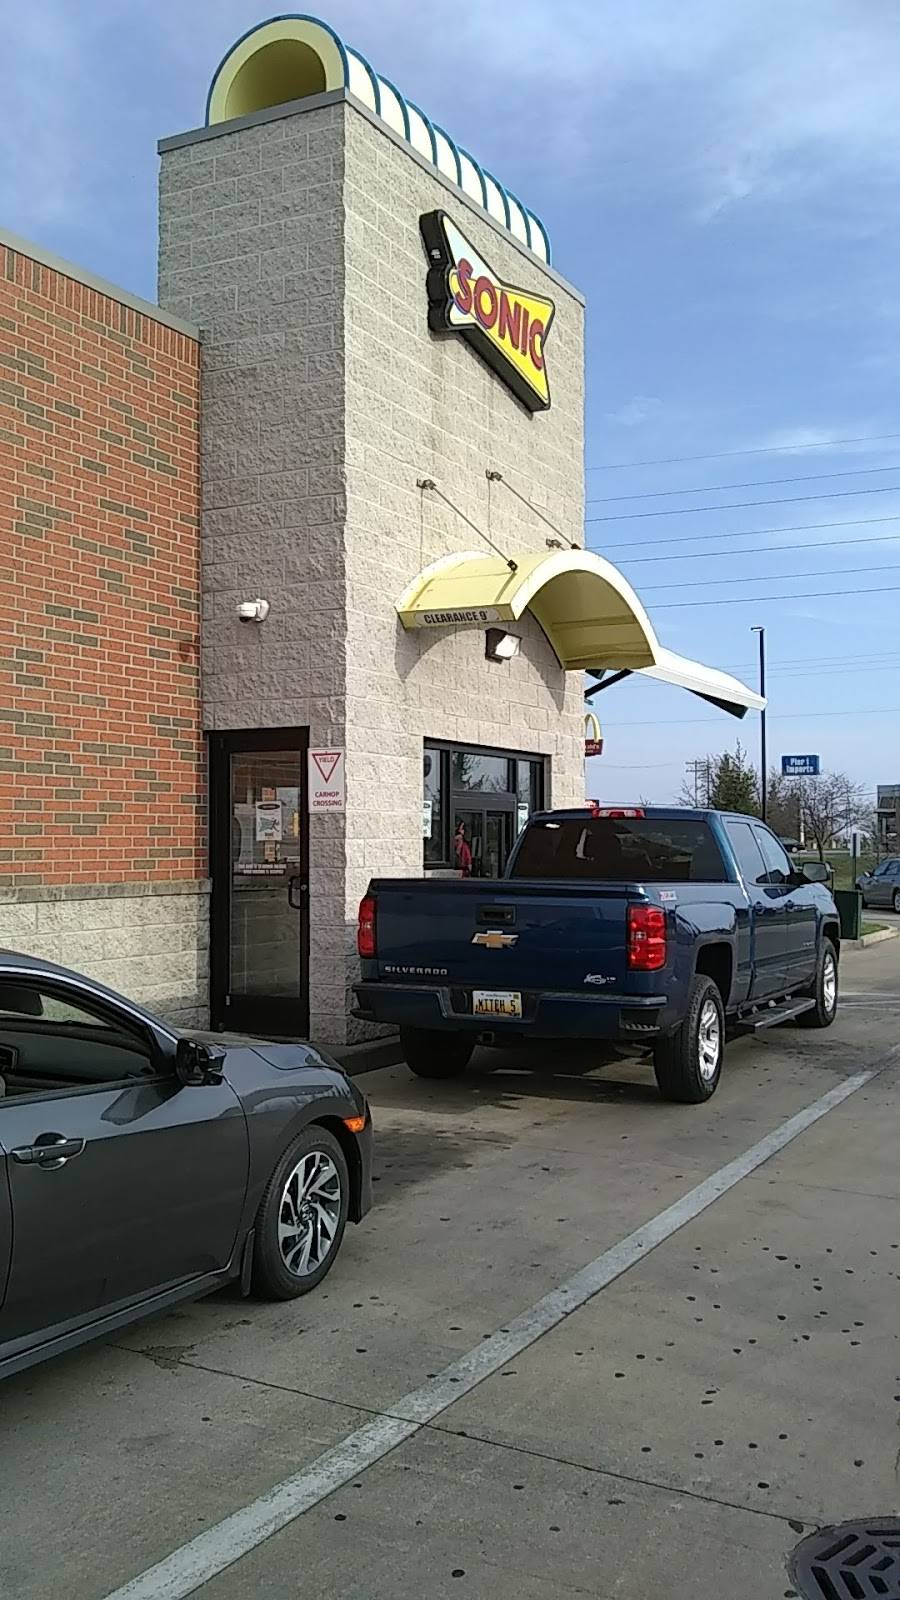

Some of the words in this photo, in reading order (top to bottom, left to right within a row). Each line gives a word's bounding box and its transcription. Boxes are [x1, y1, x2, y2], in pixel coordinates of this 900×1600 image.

[453, 258, 545, 371] SONIC
[423, 610, 478, 625] CLEARANCE
[790, 757, 805, 766] Pier
[786, 764, 814, 774] Imports
[312, 799, 342, 807] CROSSING
[384, 965, 448, 975] SILVERADO
